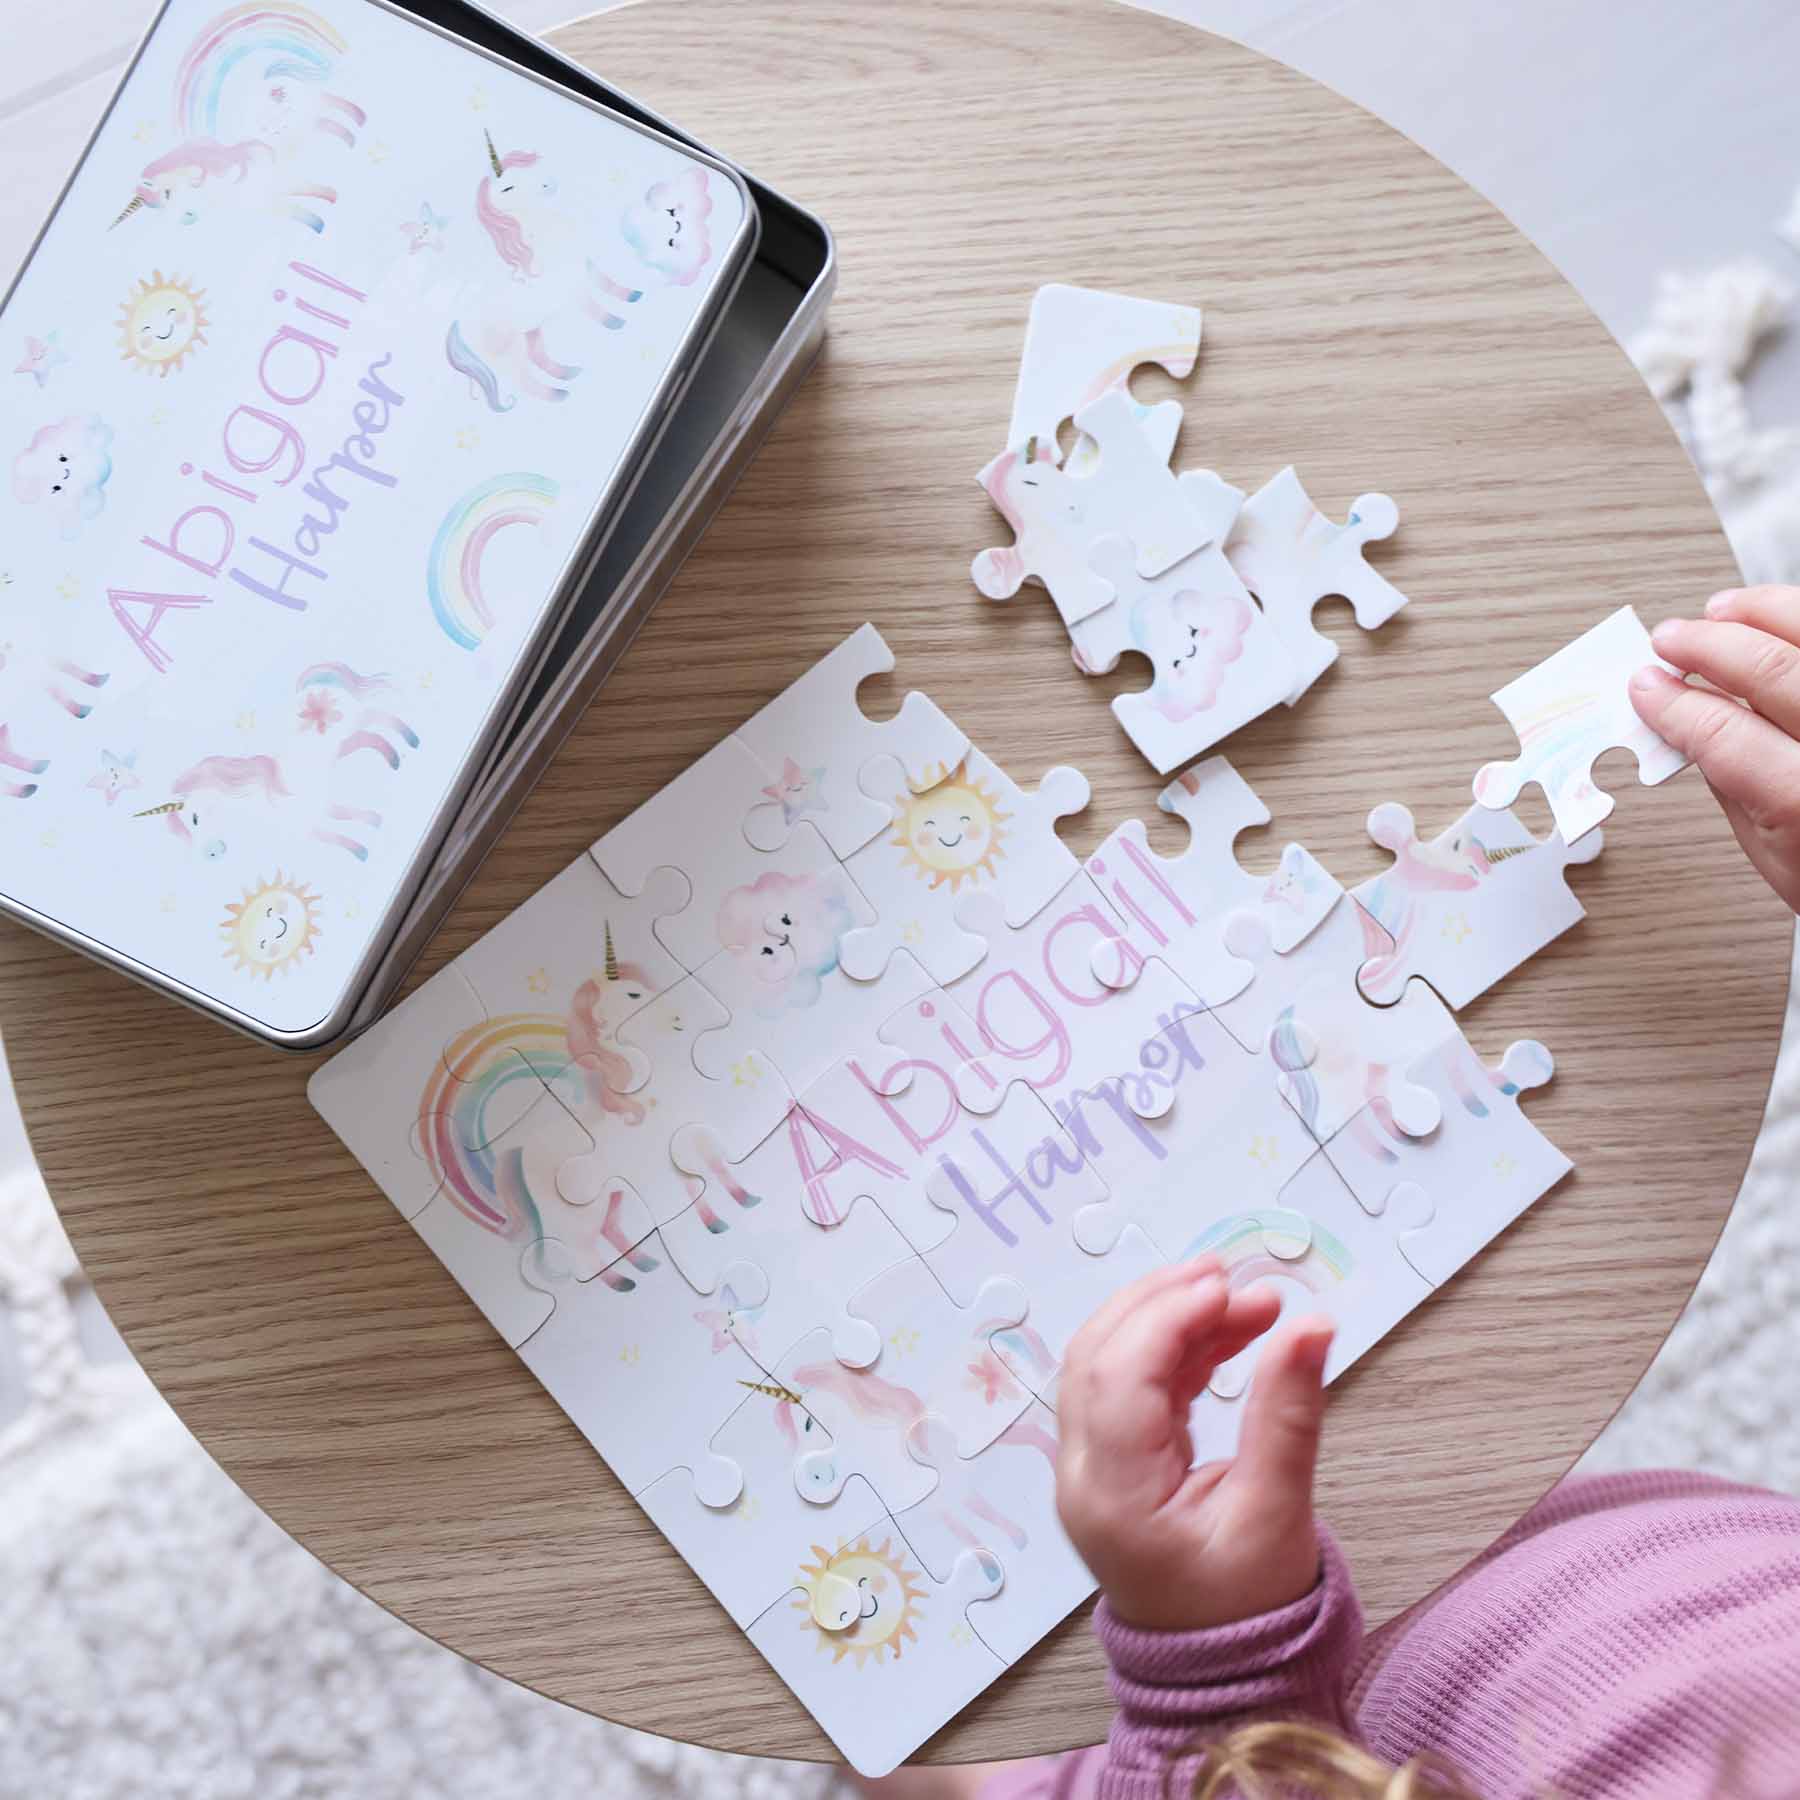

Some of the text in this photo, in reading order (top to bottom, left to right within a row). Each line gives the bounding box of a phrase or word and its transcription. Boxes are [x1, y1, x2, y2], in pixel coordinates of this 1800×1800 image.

[107, 261, 367, 673] Abigail
[229, 352, 405, 612] Harper
[788, 837, 1197, 1232] Abigail
[938, 1000, 1206, 1248] Harper
